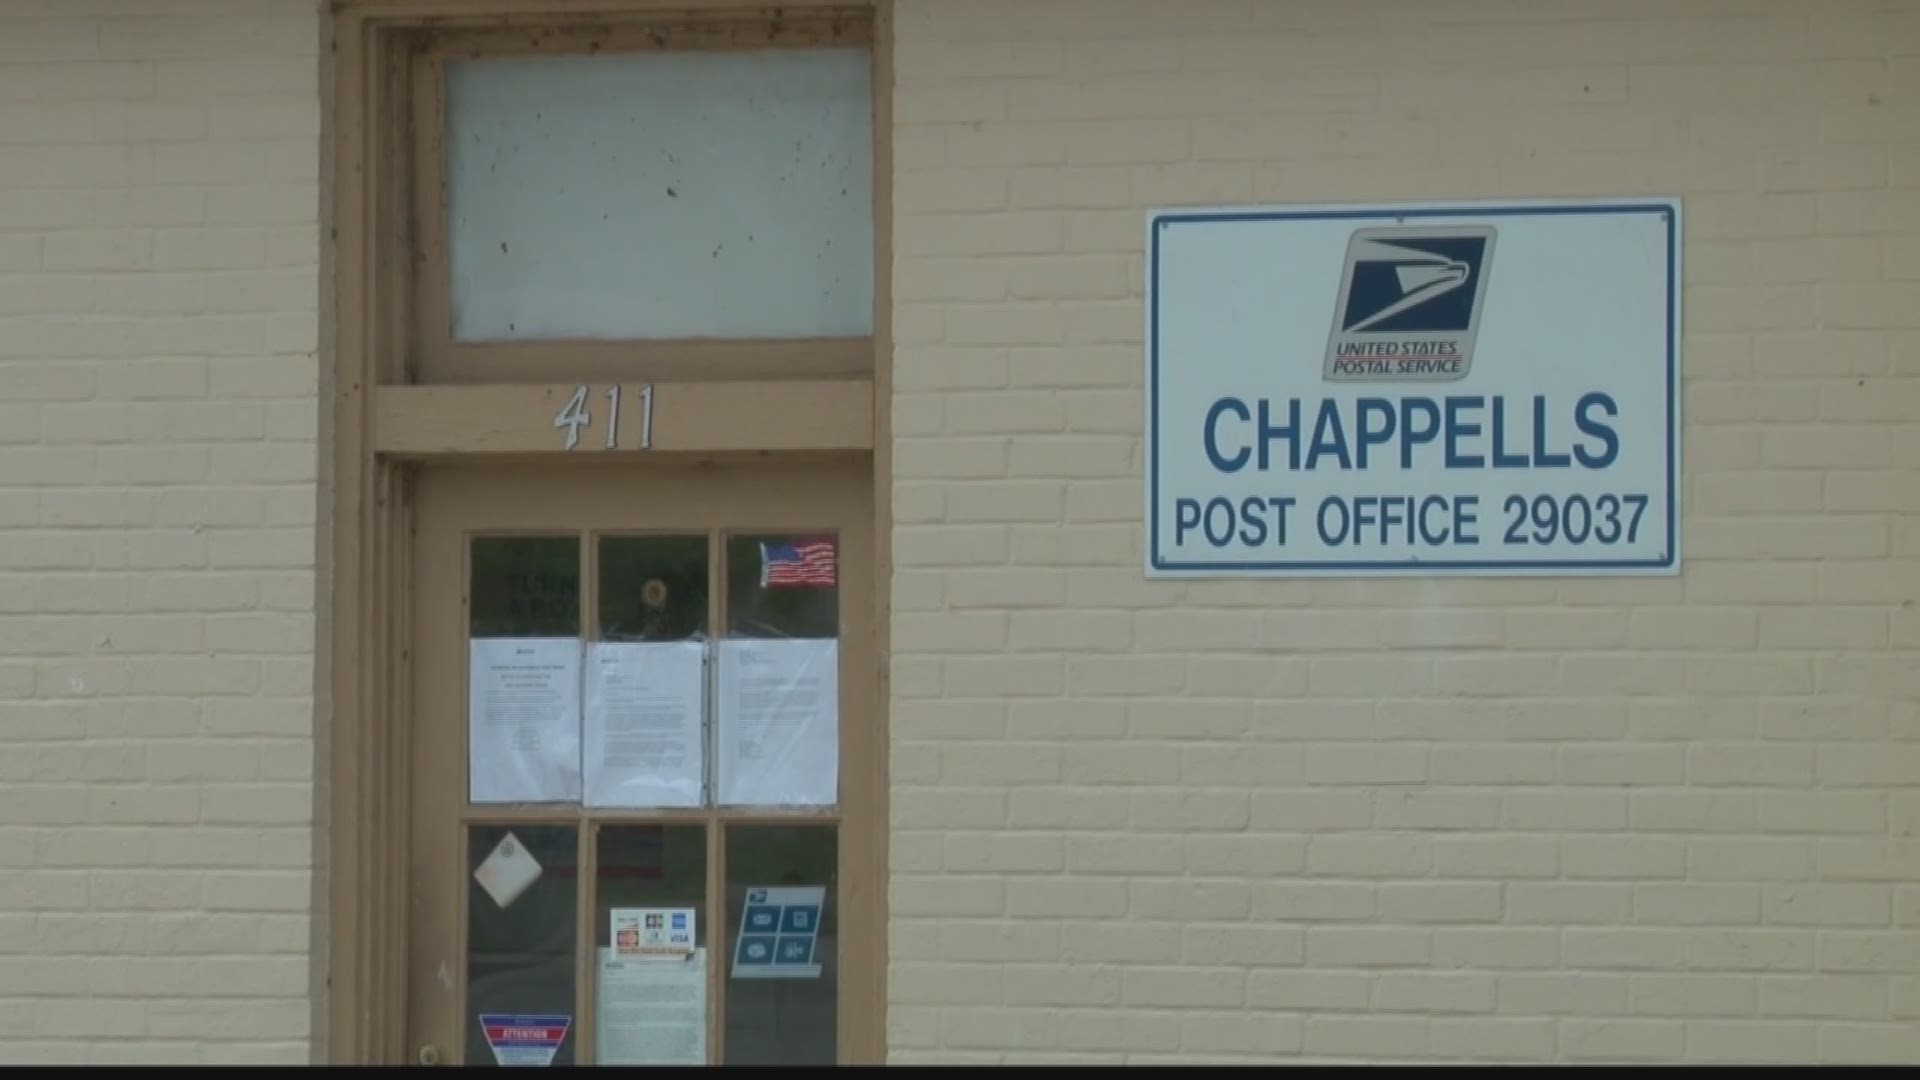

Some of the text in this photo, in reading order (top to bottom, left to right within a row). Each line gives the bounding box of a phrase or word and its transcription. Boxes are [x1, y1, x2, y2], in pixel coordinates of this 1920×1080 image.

[1336, 340, 1459, 356] UNITED STATES
[1333, 358, 1463, 374] POSTAL SERVICE
[553, 383, 655, 451] 411
[1203, 391, 1620, 473] CHAPPELLS
[1175, 493, 1650, 547] POST OFFICE 29037
[670, 933, 689, 943] VISA
[503, 1028, 548, 1039] ATTENTION
